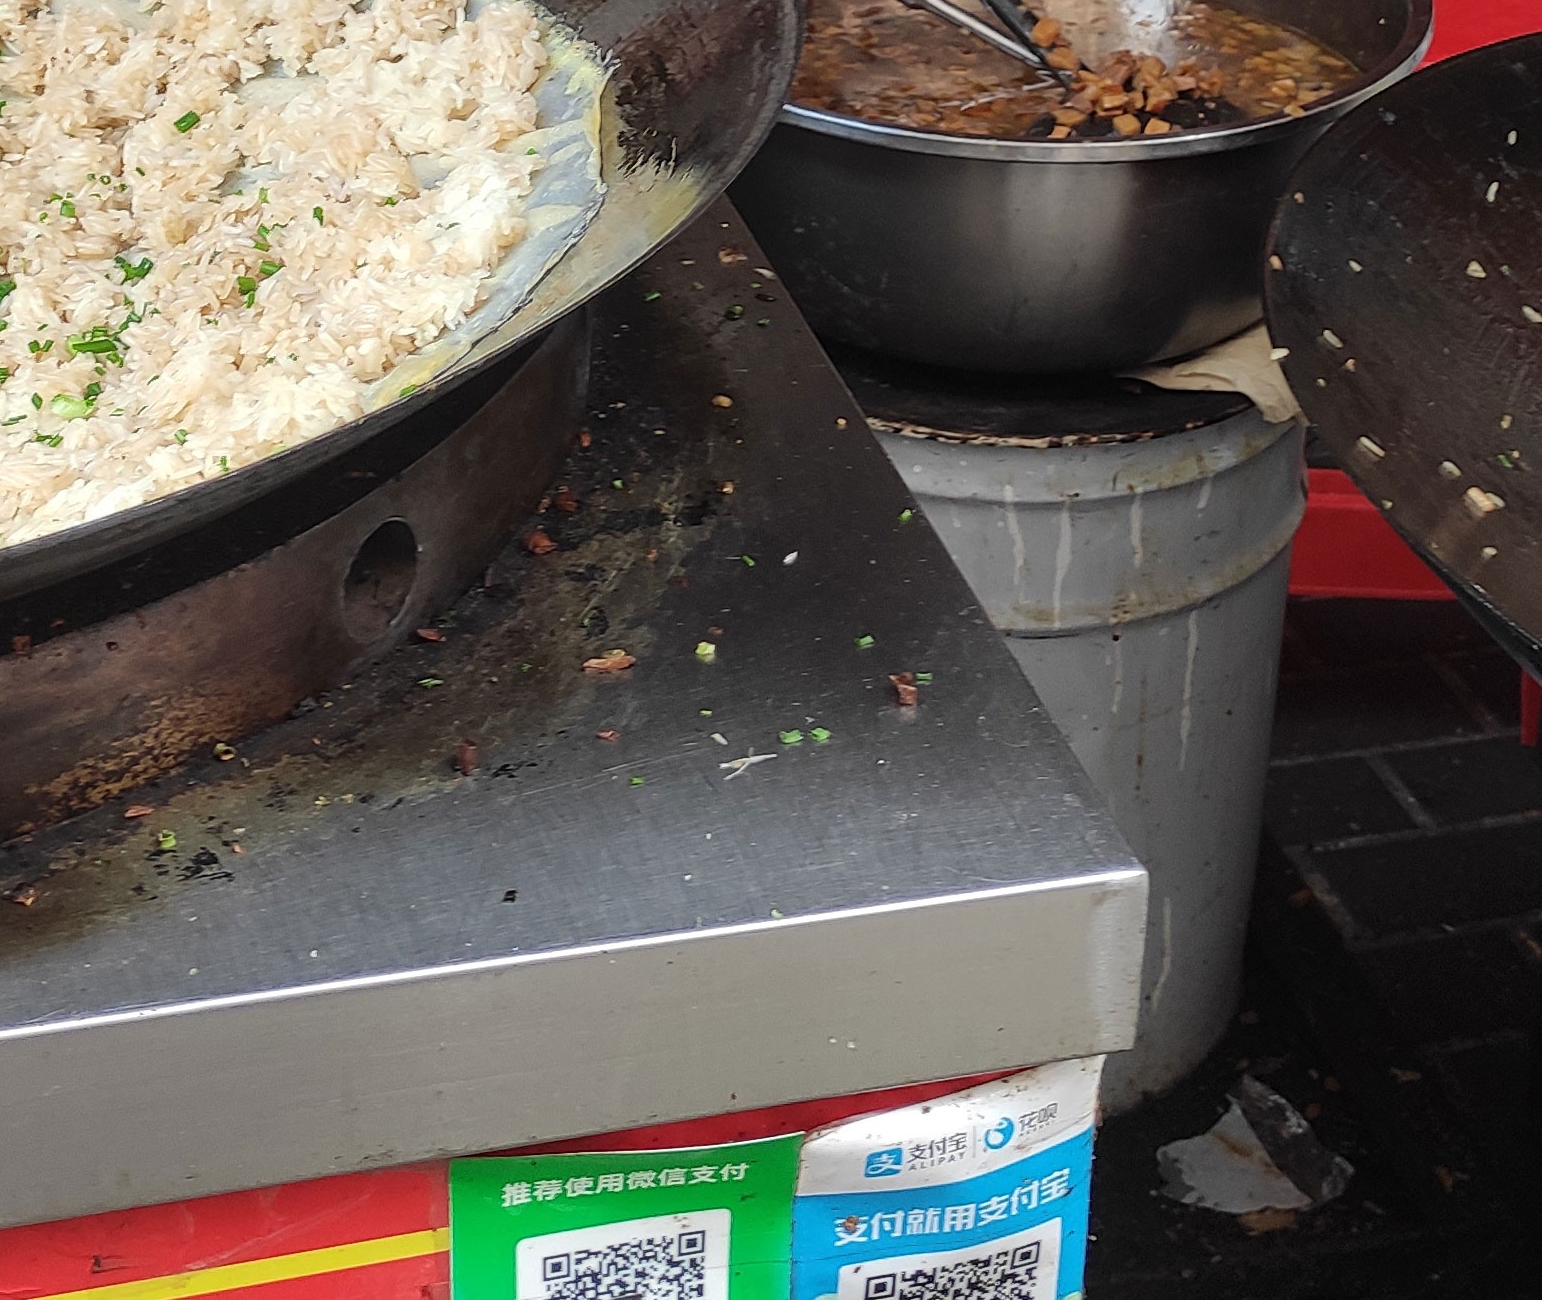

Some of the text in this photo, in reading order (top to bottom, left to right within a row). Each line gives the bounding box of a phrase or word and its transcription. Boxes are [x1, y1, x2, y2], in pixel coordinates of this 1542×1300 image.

[907, 1132, 968, 1163] 支付宝
[908, 1152, 965, 1171] ALIPAY
[501, 1162, 750, 1208] 推荐使用微信支付
[833, 1168, 1071, 1247] 支付就用支付宝
